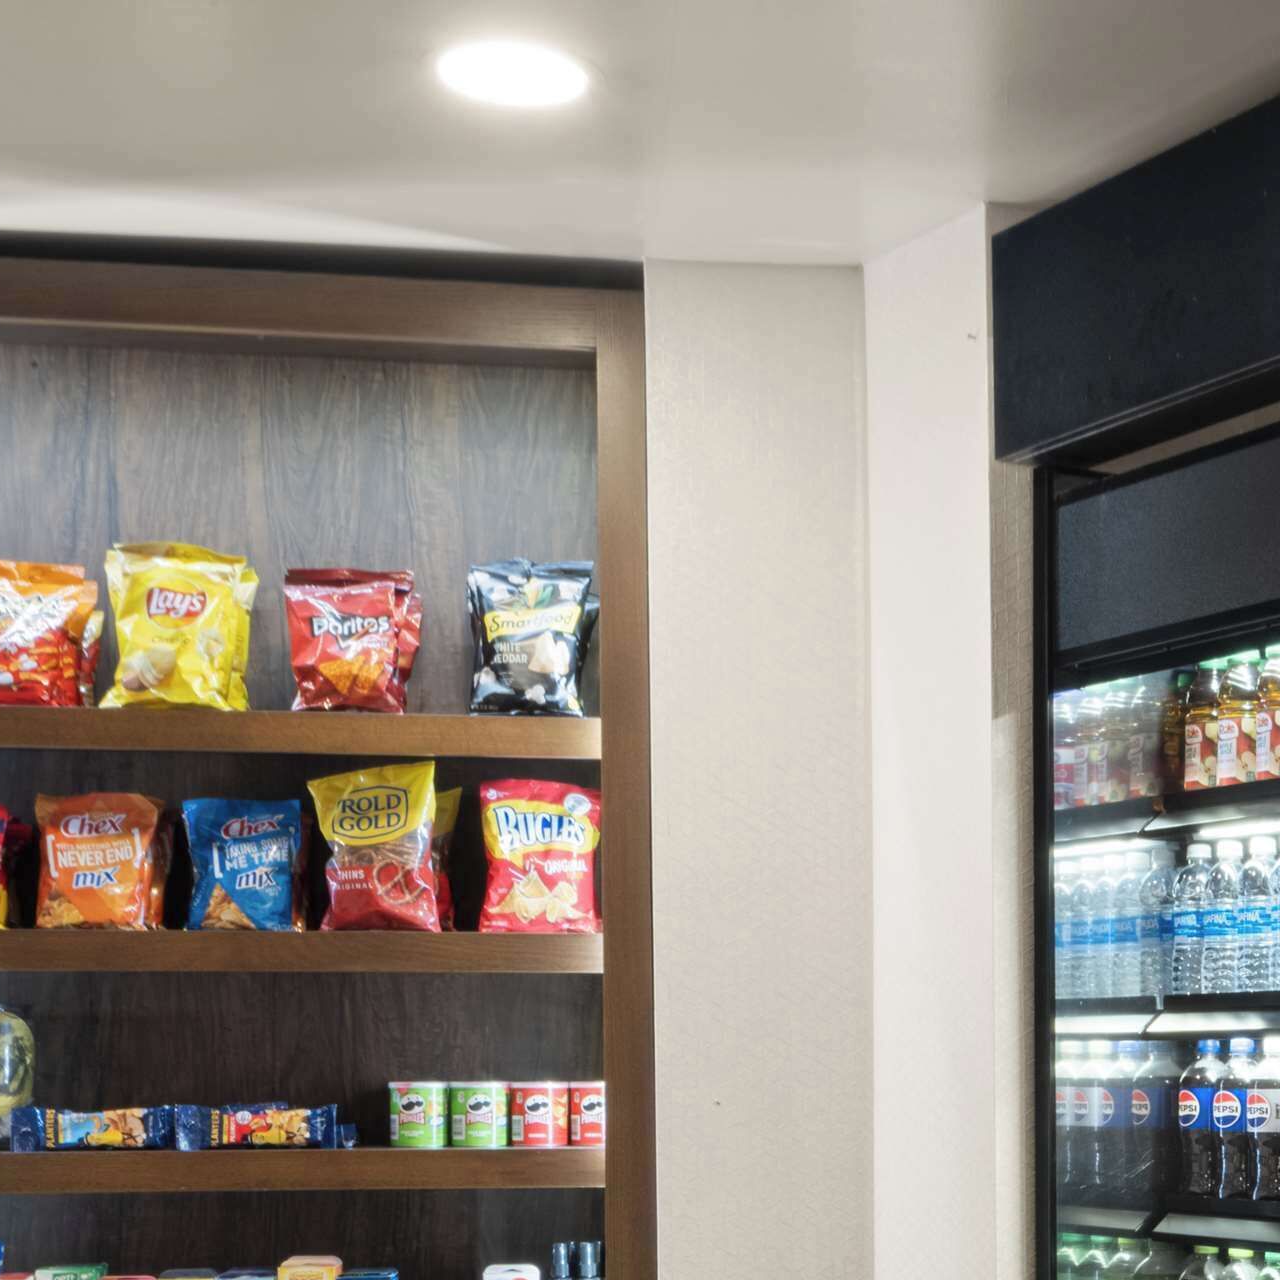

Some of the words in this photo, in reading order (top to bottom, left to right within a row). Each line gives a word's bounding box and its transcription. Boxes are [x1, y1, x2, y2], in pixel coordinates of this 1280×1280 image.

[149, 587, 205, 618] Lay's
[312, 615, 392, 638] Doritos
[489, 611, 574, 633] Smartfood
[491, 653, 528, 665] EDDAR
[341, 794, 402, 815] ROLD
[61, 814, 127, 838] Chex
[221, 815, 285, 839] Chex
[339, 813, 402, 832] GOLD
[493, 805, 585, 849] BUGLES
[57, 850, 104, 868] NEVER
[106, 847, 133, 864] END
[225, 856, 249, 871] ME
[336, 882, 373, 890] RIGINAL
[1214, 1104, 1239, 1114] PEPSI
